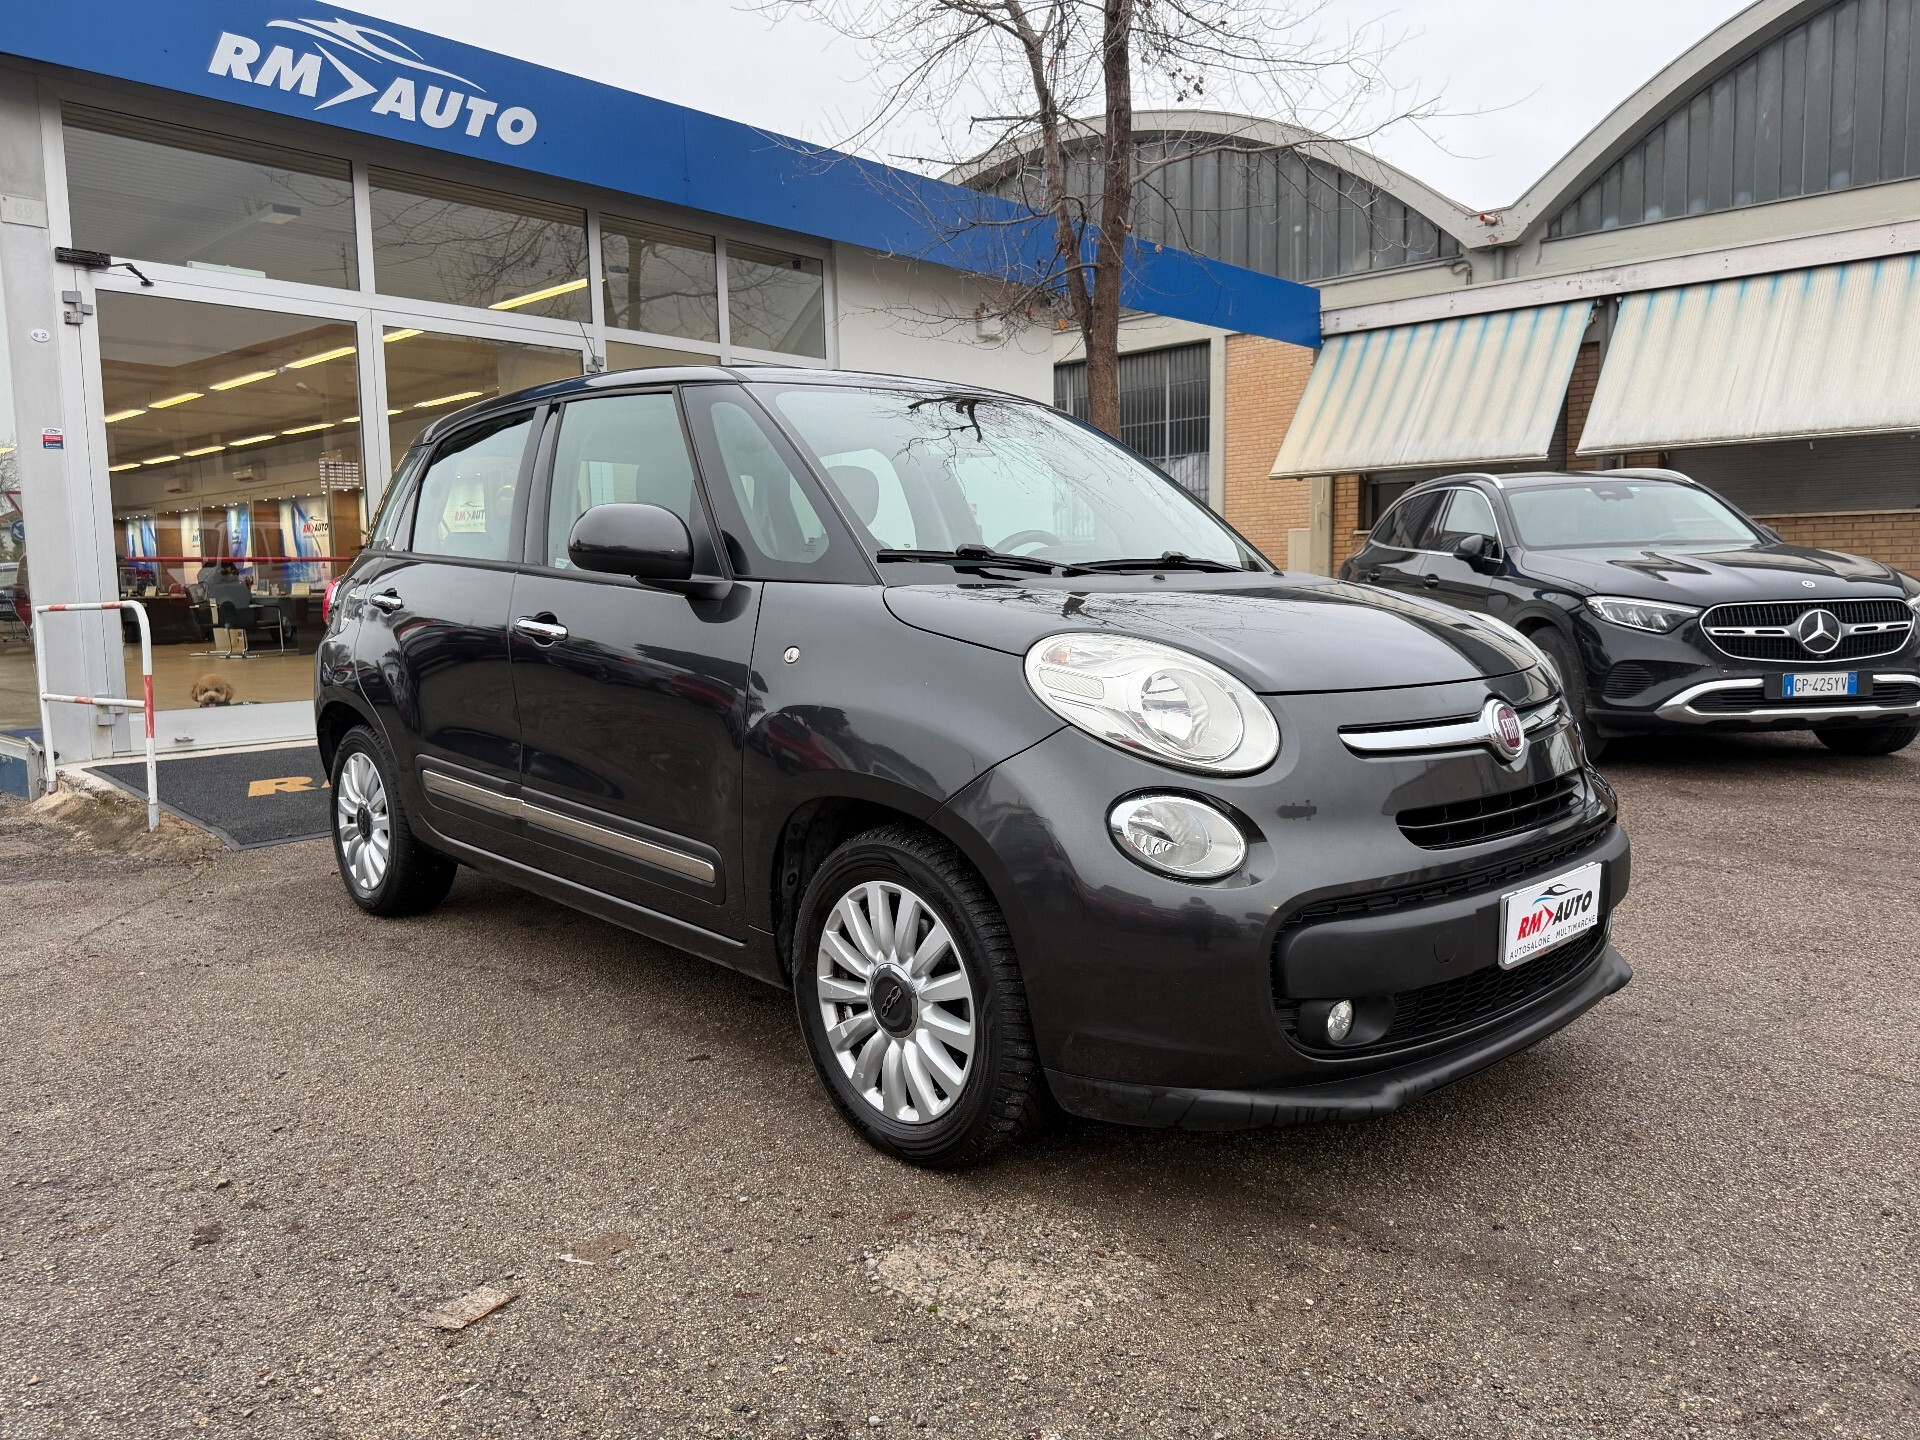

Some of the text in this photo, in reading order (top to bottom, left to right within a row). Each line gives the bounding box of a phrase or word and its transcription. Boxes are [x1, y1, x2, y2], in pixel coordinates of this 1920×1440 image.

[207, 31, 538, 146] RM AUTO
[1509, 935, 1551, 960] AUTOSALONE
[1555, 914, 1596, 939] MULTIMARCHE
[1517, 890, 1593, 941] RM AUTO
